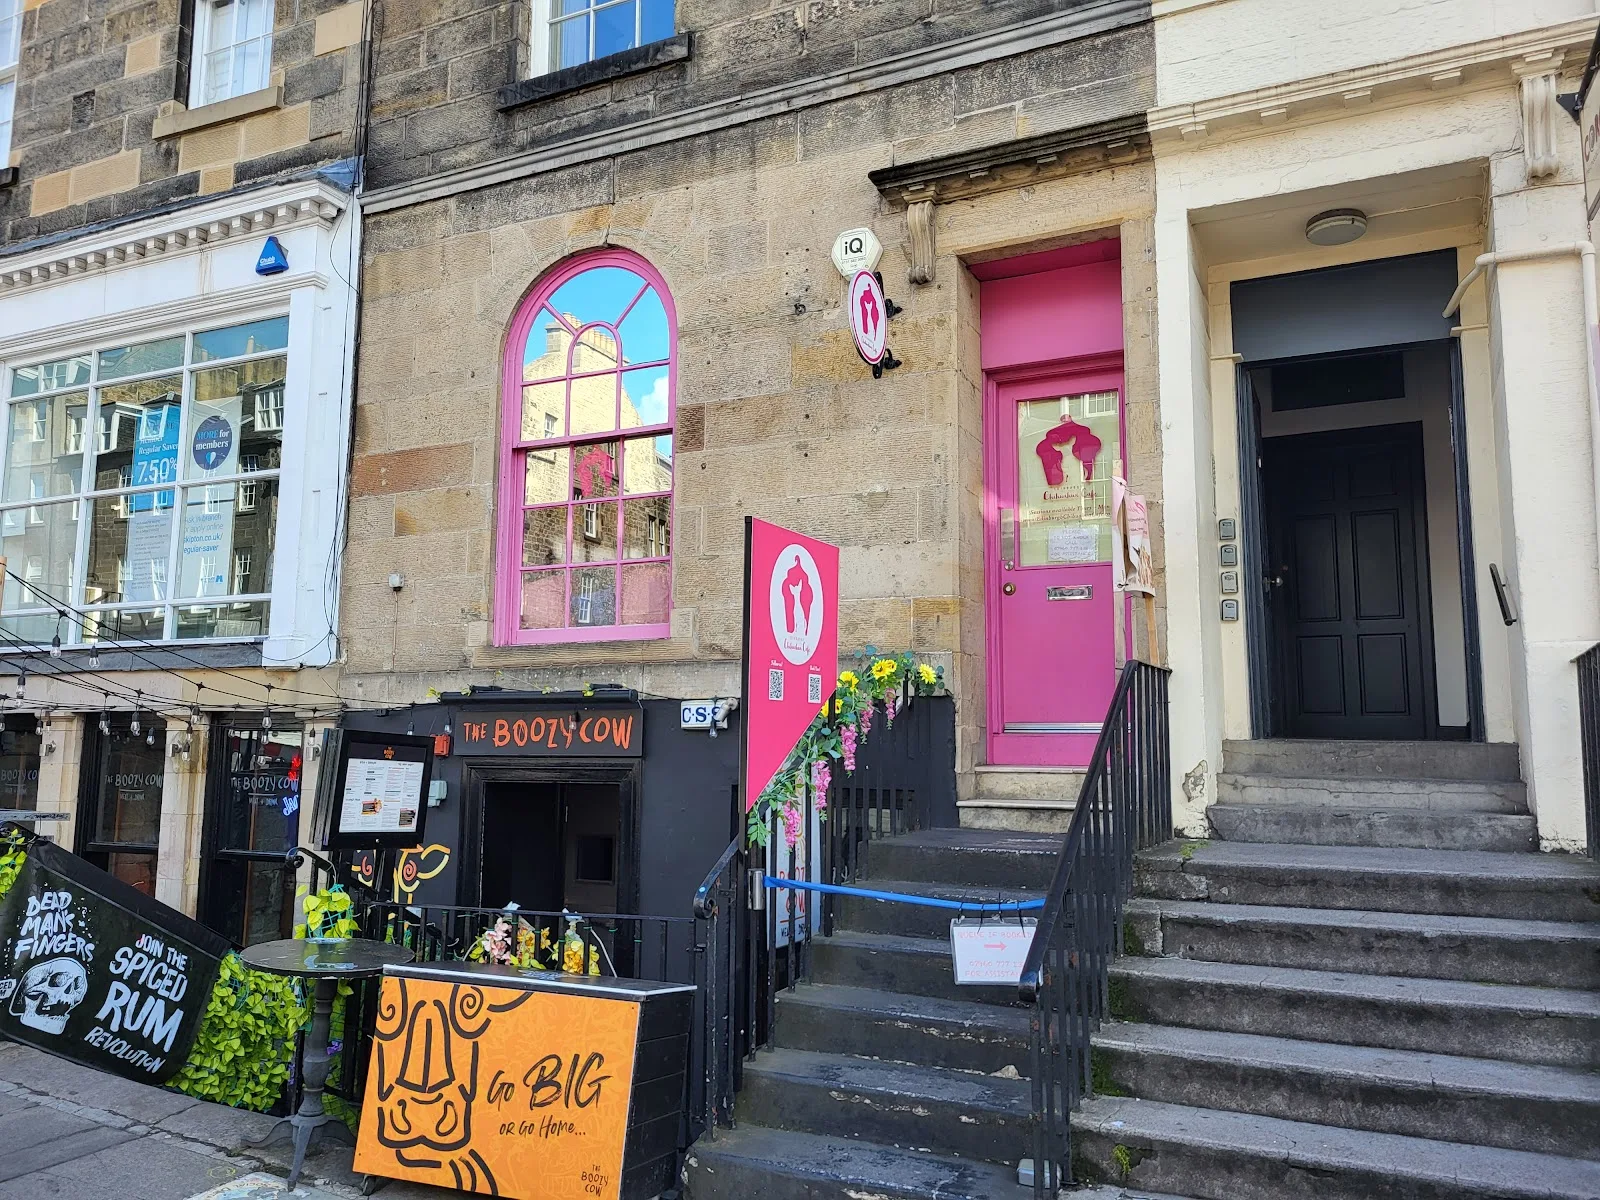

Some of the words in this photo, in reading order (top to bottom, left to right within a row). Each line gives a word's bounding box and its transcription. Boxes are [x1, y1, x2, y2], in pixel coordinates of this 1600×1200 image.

[844, 237, 863, 255] iQ
[196, 429, 219, 441] MORE
[219, 428, 231, 439] for
[138, 445, 161, 455] Regular
[195, 440, 229, 451] members
[137, 456, 178, 483] 7.50%
[205, 522, 223, 531] online
[184, 544, 219, 555] egular-saver
[463, 721, 488, 743] THE
[492, 713, 573, 749] BOOZY
[579, 715, 633, 749] COW
[27, 769, 38, 781] CO
[115, 772, 144, 788] BOOZY
[145, 773, 164, 789] COW
[243, 775, 276, 791] BOOZY
[26, 891, 72, 916] DEAD
[14, 932, 95, 962] FINGERS
[135, 933, 164, 958] JOIN
[166, 945, 188, 971] THE
[109, 946, 188, 1002] SPICED
[95, 981, 184, 1053] RUM
[83, 1026, 166, 1074] REVOLUTION
[522, 1051, 613, 1111] BIG
[580, 1171, 609, 1187] BOOZY
[584, 1183, 603, 1197] COW
